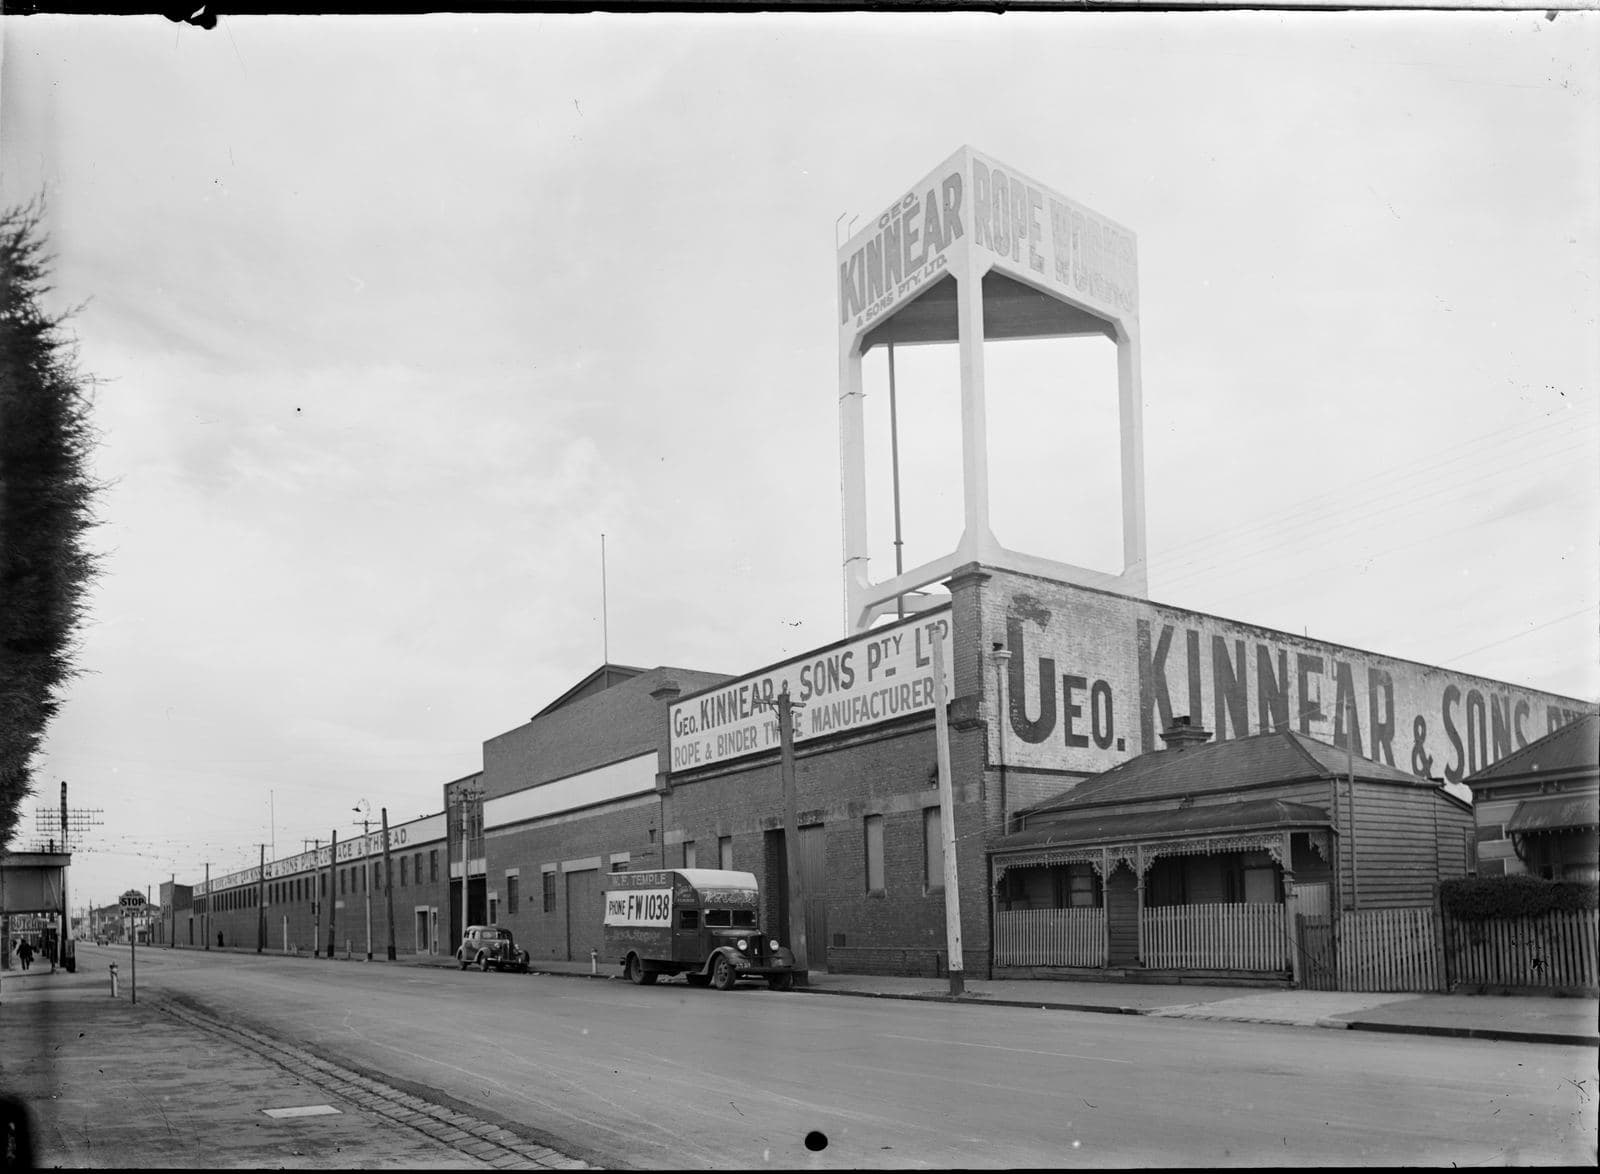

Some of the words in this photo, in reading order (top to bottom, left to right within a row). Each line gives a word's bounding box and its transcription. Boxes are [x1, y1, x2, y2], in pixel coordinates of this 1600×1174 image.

[878, 192, 918, 229] GEO.
[973, 158, 1045, 275] ROPE
[840, 172, 964, 326] KINNEAR
[856, 314, 864, 326] &
[865, 288, 895, 322] SONS
[674, 708, 699, 738] GEO.
[700, 678, 774, 731] KINNEAR
[800, 651, 855, 702] SONS
[868, 633, 904, 682] PTY
[1007, 593, 1126, 752] GEO.
[1137, 618, 1397, 767] KINNEAR
[1412, 713, 1434, 779] &
[1442, 684, 1530, 784] SONS
[674, 740, 701, 768] ROPE
[704, 741, 713, 760] &
[717, 724, 758, 757] BINDER
[763, 712, 804, 744] TWE
[812, 675, 949, 734] MANUFACTURER
[320, 845, 352, 865] CORAGE
[631, 873, 667, 885] TEMPLE
[119, 897, 145, 907] STOP
[608, 899, 626, 917] PHONE
